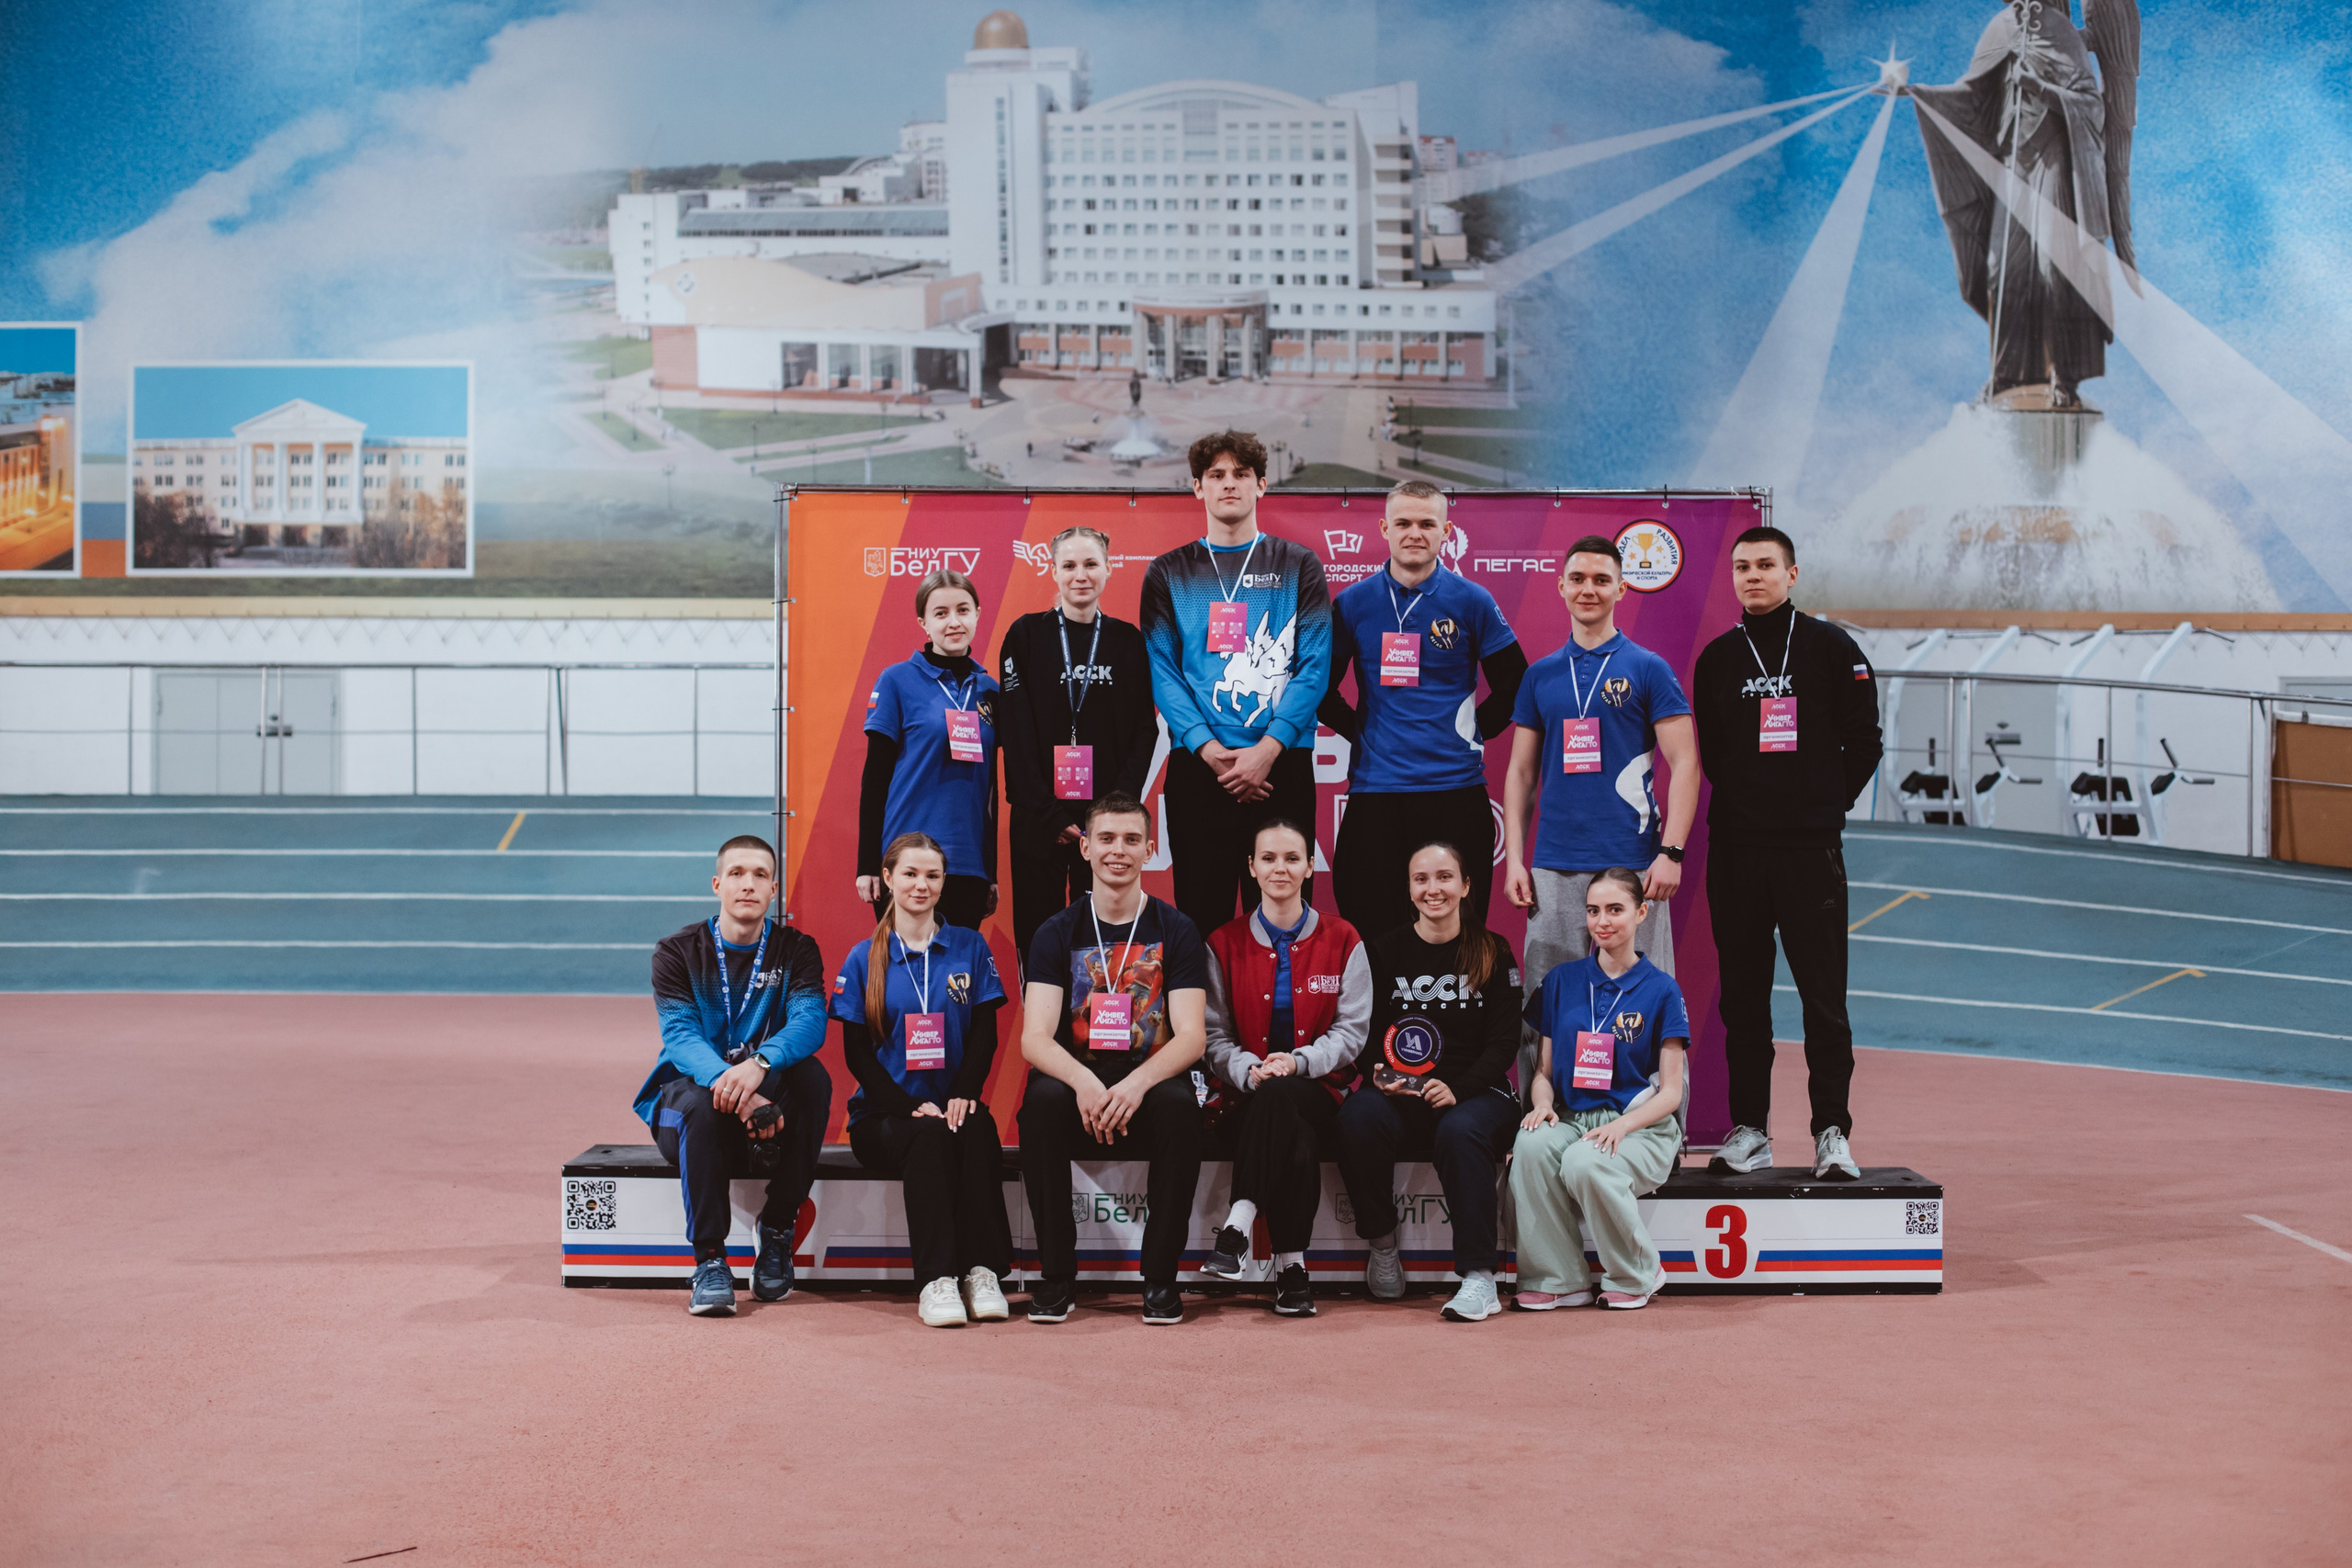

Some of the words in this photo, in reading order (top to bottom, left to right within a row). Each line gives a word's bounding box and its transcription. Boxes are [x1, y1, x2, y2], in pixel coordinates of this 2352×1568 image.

[908, 547, 941, 558] НИУ
[1657, 528, 1678, 565] РАЗВИТИЯ
[890, 552, 980, 576] БелГУ
[1474, 558, 1555, 571] ПЕГАС
[1742, 675, 1792, 694] АССК
[1391, 975, 1483, 1001] АССК
[1390, 1001, 1483, 1010] ОССИИ
[1385, 1027, 1396, 1063] ПОБЕДИТЕЛЬ
[1095, 1198, 1148, 1223] Бел
[1114, 1193, 1148, 1204] НИУ
[1395, 1194, 1416, 1205] ИУ
[1400, 1199, 1451, 1224] лГУ
[1705, 1204, 1747, 1280] 3
